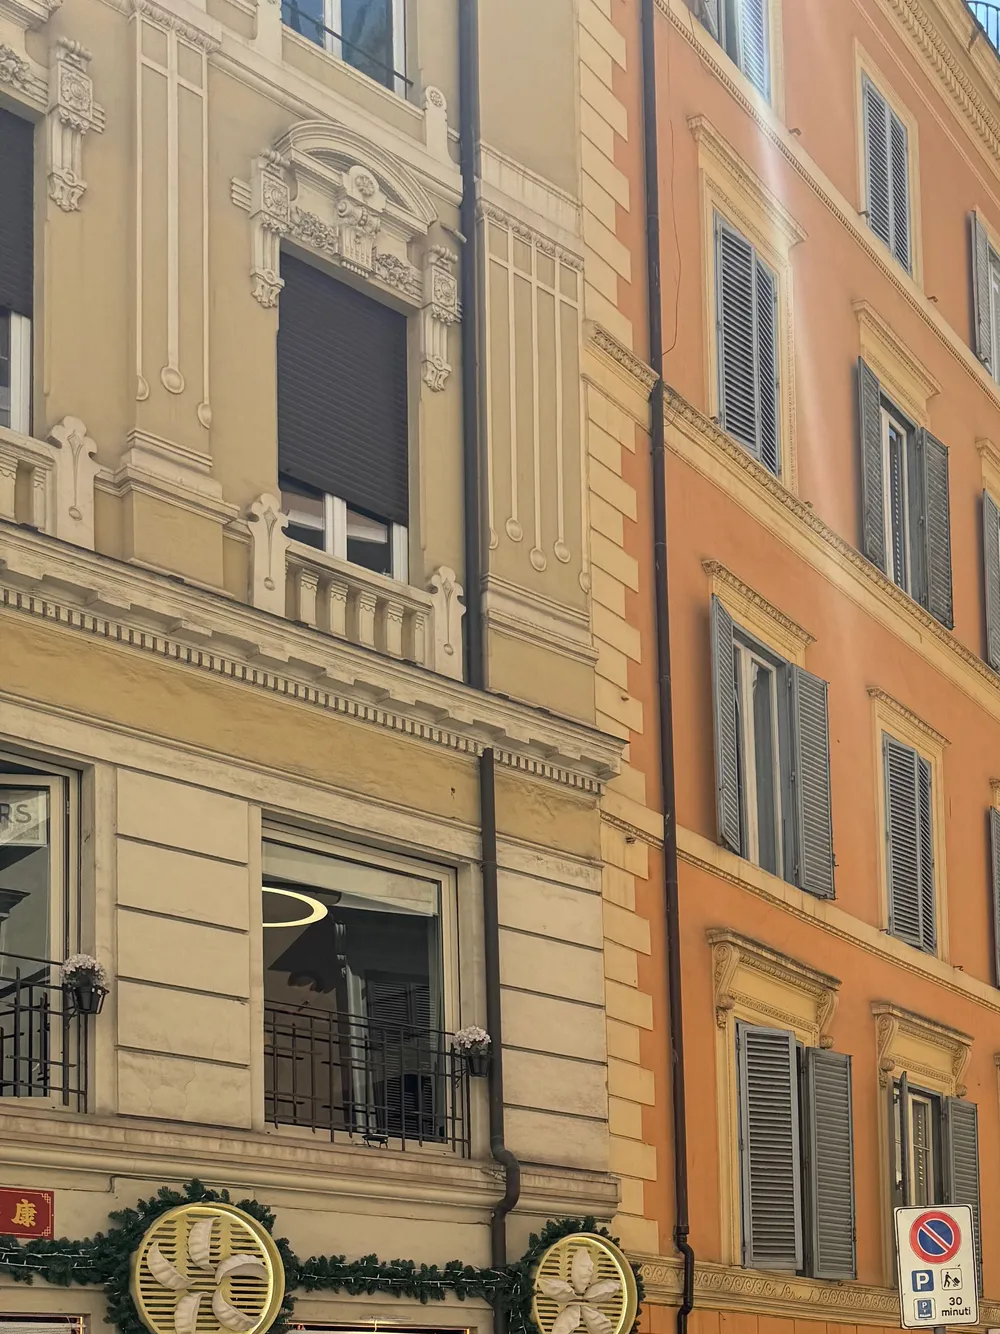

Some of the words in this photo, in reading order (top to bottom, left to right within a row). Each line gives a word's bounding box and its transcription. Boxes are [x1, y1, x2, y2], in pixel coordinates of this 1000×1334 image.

[915, 1272, 931, 1290] P
[948, 1296, 963, 1306] 30
[941, 1307, 971, 1317] minuti
